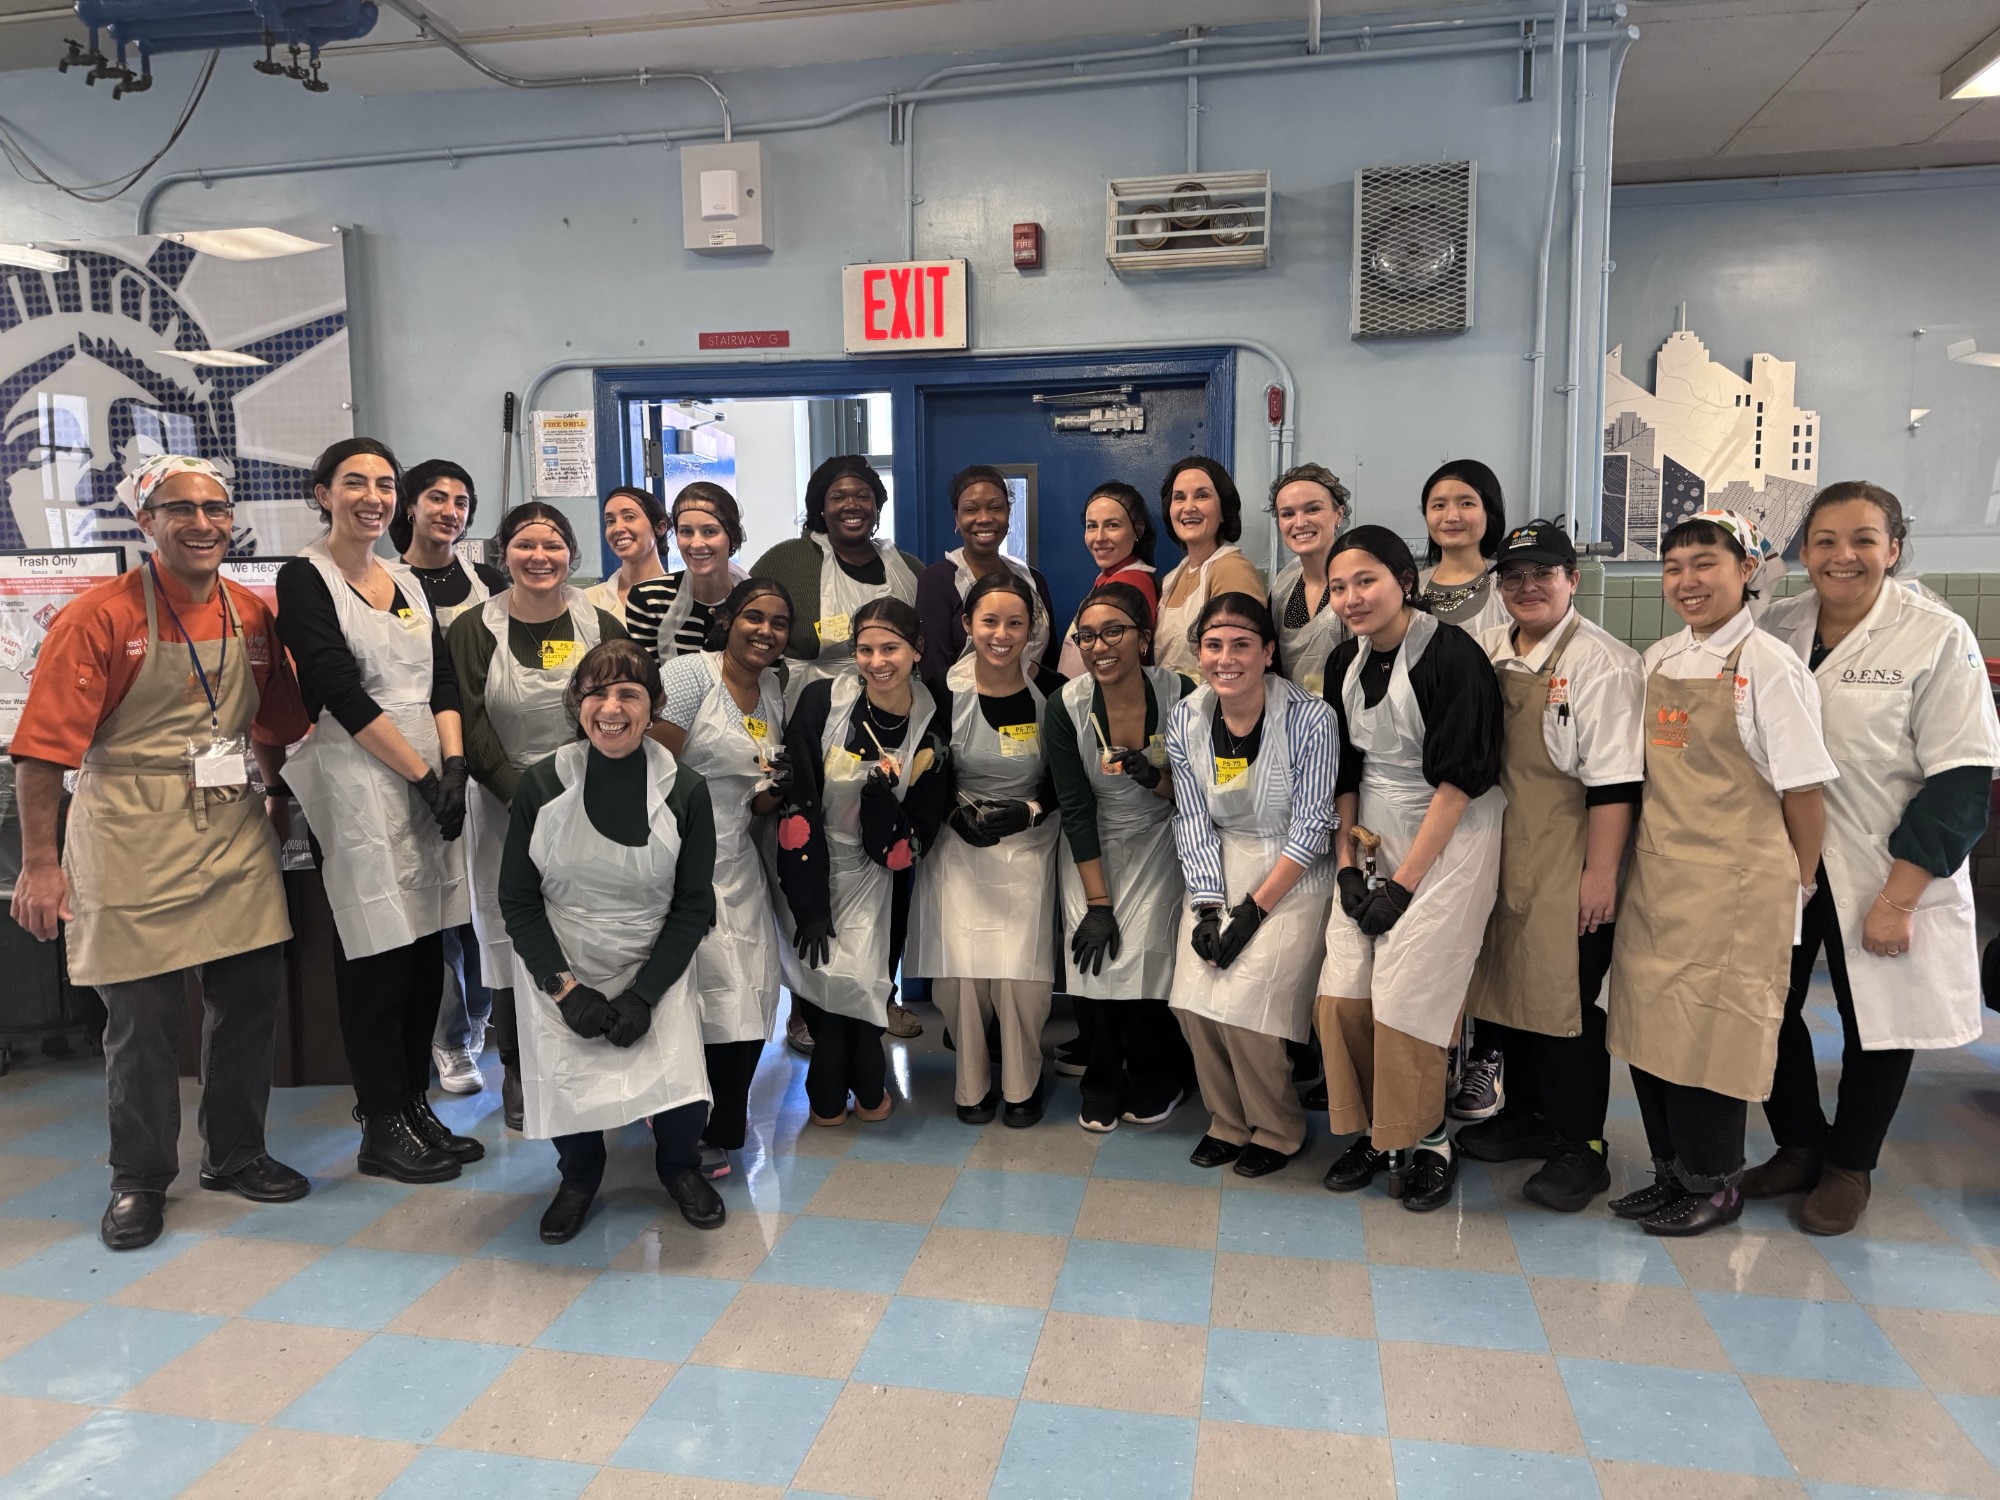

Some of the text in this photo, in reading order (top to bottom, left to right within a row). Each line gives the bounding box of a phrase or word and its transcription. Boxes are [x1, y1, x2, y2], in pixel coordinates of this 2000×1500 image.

[1015, 241, 1033, 249] FIRE
[863, 266, 950, 341] EXIT
[708, 333, 778, 346] STAIRWAY G
[17, 555, 78, 568] Trash Only
[230, 562, 281, 575] We Recy
[126, 644, 143, 656] real
